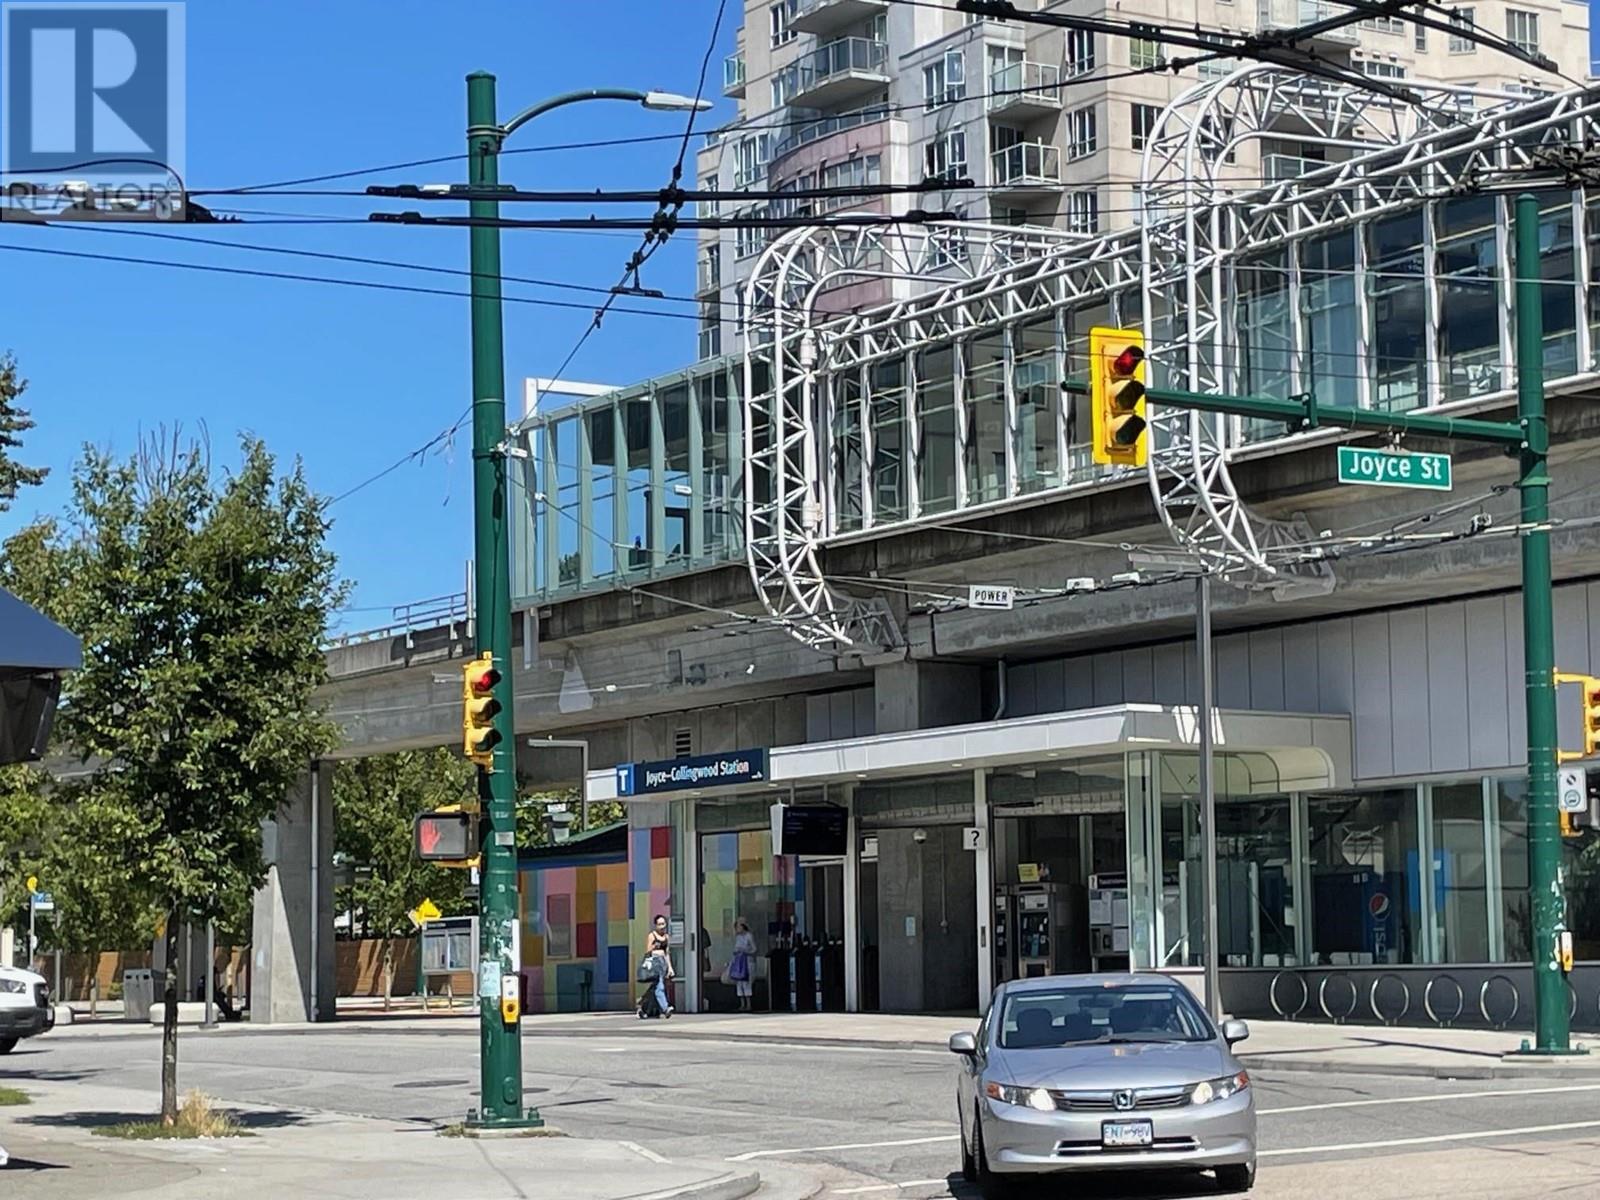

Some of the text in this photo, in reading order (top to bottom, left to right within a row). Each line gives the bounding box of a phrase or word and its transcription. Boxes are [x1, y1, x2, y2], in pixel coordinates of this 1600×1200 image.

[1349, 452, 1442, 481] Joyce St
[975, 590, 1007, 602] POWER
[720, 759, 749, 776] Station
